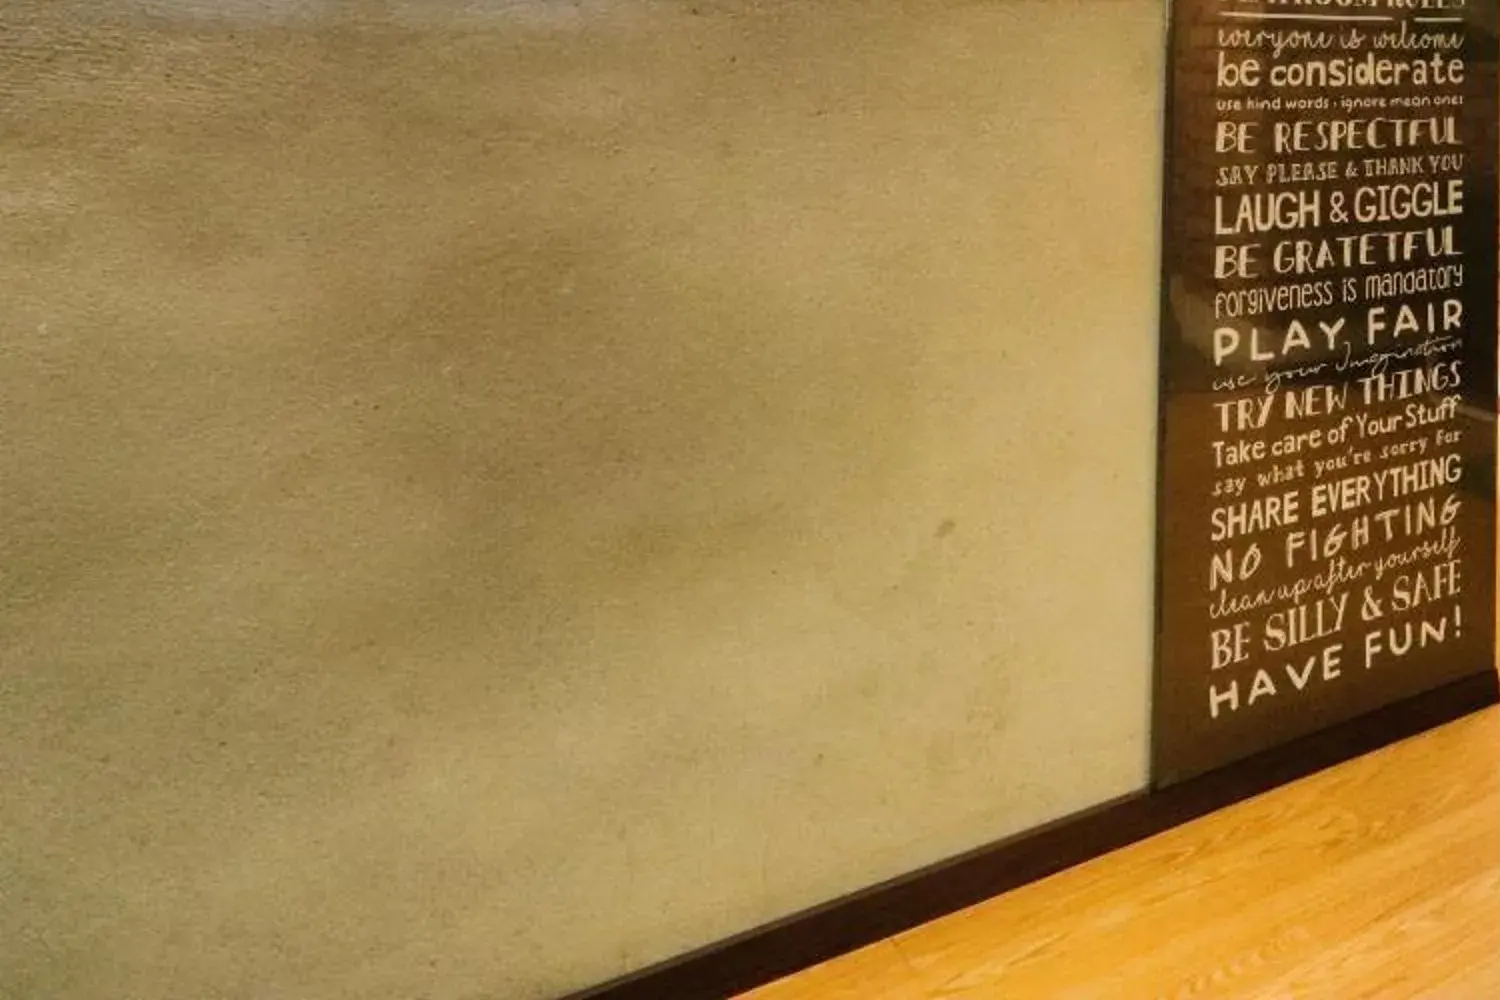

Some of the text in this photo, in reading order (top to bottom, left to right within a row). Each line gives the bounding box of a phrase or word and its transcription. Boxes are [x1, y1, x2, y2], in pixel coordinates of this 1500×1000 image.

[1217, 20, 1465, 60] everyone is welcome
[1217, 51, 1465, 88] be considerate
[1216, 99, 1242, 111] use
[1285, 96, 1329, 110] words
[1340, 96, 1387, 113] ignore
[1215, 116, 1464, 154] BE RESPECTFUL
[1216, 153, 1465, 187] SAY PLEASE & THANK YOU
[1215, 179, 1464, 235] LAUGH & GIGGLE
[1214, 243, 1261, 280] BE
[1342, 277, 1358, 304] is
[1365, 263, 1464, 300] mandatory
[1213, 298, 1464, 367] PLAY FAIR
[1212, 374, 1256, 392] use
[1265, 362, 1328, 395] your
[1213, 359, 1463, 433] TRY NEW THINGS
[1212, 393, 1463, 468] Take care of Your Stuff
[1211, 476, 1247, 498] say
[1257, 459, 1305, 488] what
[1314, 446, 1372, 479] you're
[1379, 435, 1429, 460] sorry
[1211, 453, 1463, 542] SHARE EVERYTHING
[1209, 492, 1463, 592] NO FIGHTING
[1209, 525, 1462, 620] clean up after yourself
[1211, 558, 1463, 671] BE SILLY & SAFE
[1209, 604, 1462, 720] HAVE FUN!
